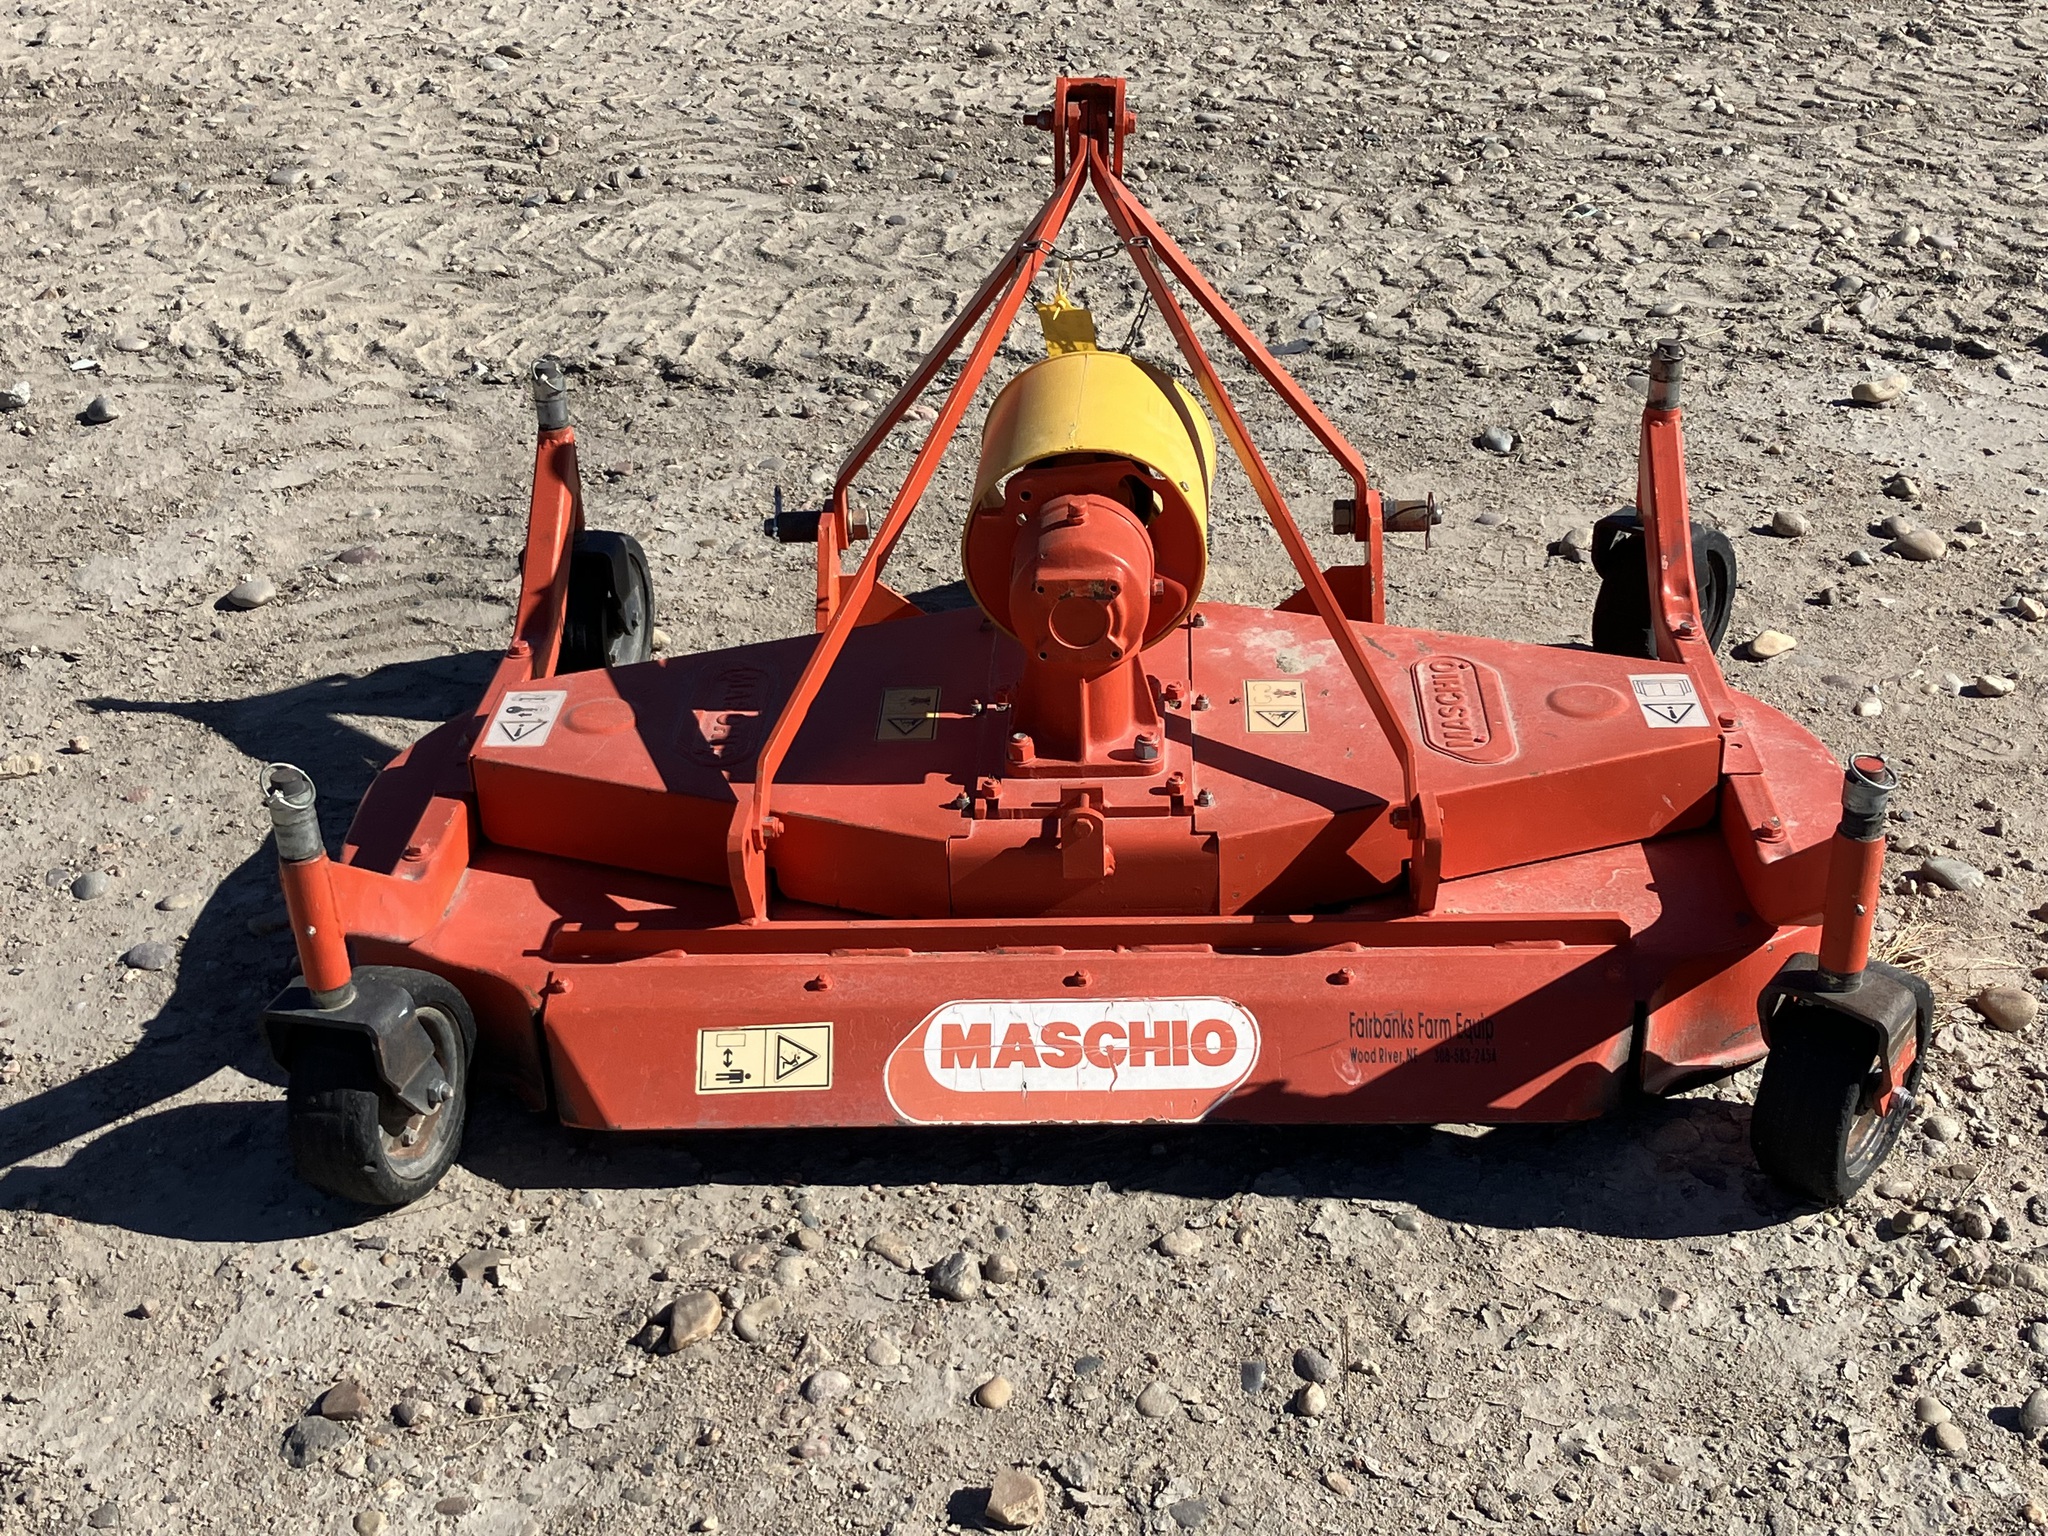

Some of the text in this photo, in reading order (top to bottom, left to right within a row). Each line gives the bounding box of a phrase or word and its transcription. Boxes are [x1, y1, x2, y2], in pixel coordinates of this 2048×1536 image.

[1428, 660, 1476, 748] MASCHIO
[941, 1018, 1238, 1069] MASCHIO
[1348, 1011, 1495, 1046] Fairbanks Farm Equip
[1349, 1046, 1376, 1064] Wood
